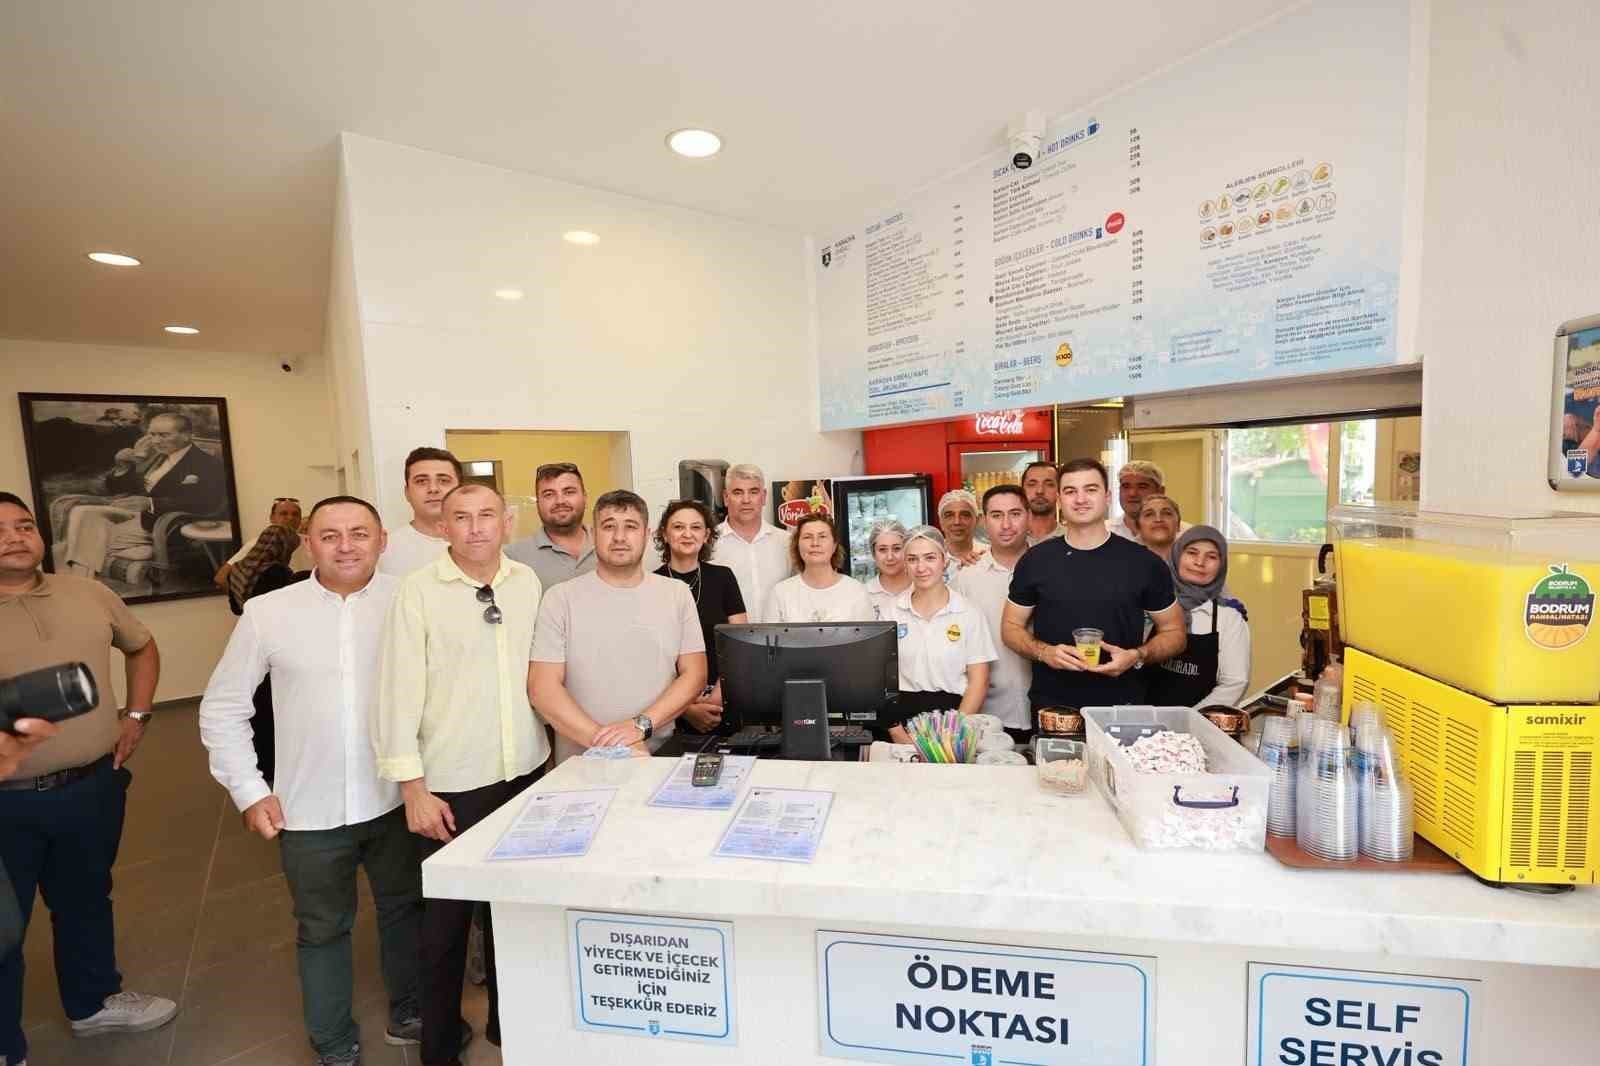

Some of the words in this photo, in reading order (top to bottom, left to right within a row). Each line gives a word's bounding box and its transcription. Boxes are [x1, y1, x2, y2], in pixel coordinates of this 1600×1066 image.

[1529, 603, 1590, 614] BODRUM
[1526, 713, 1586, 725] samixir
[610, 932, 689, 949] DIŞARIDAN
[584, 946, 642, 962] YİYECEK
[645, 951, 663, 964] VE
[667, 950, 719, 968] İÇECEK
[593, 963, 711, 984] GETİRMEDİĞİNİZ
[907, 954, 1056, 1000] ÖDEME
[637, 981, 667, 998] İÇİN
[591, 995, 662, 1012] TEŞEKKÜR
[667, 1002, 717, 1017] EDERİZ
[1304, 997, 1421, 1033] SELF
[896, 1002, 1069, 1045] NOKTASI
